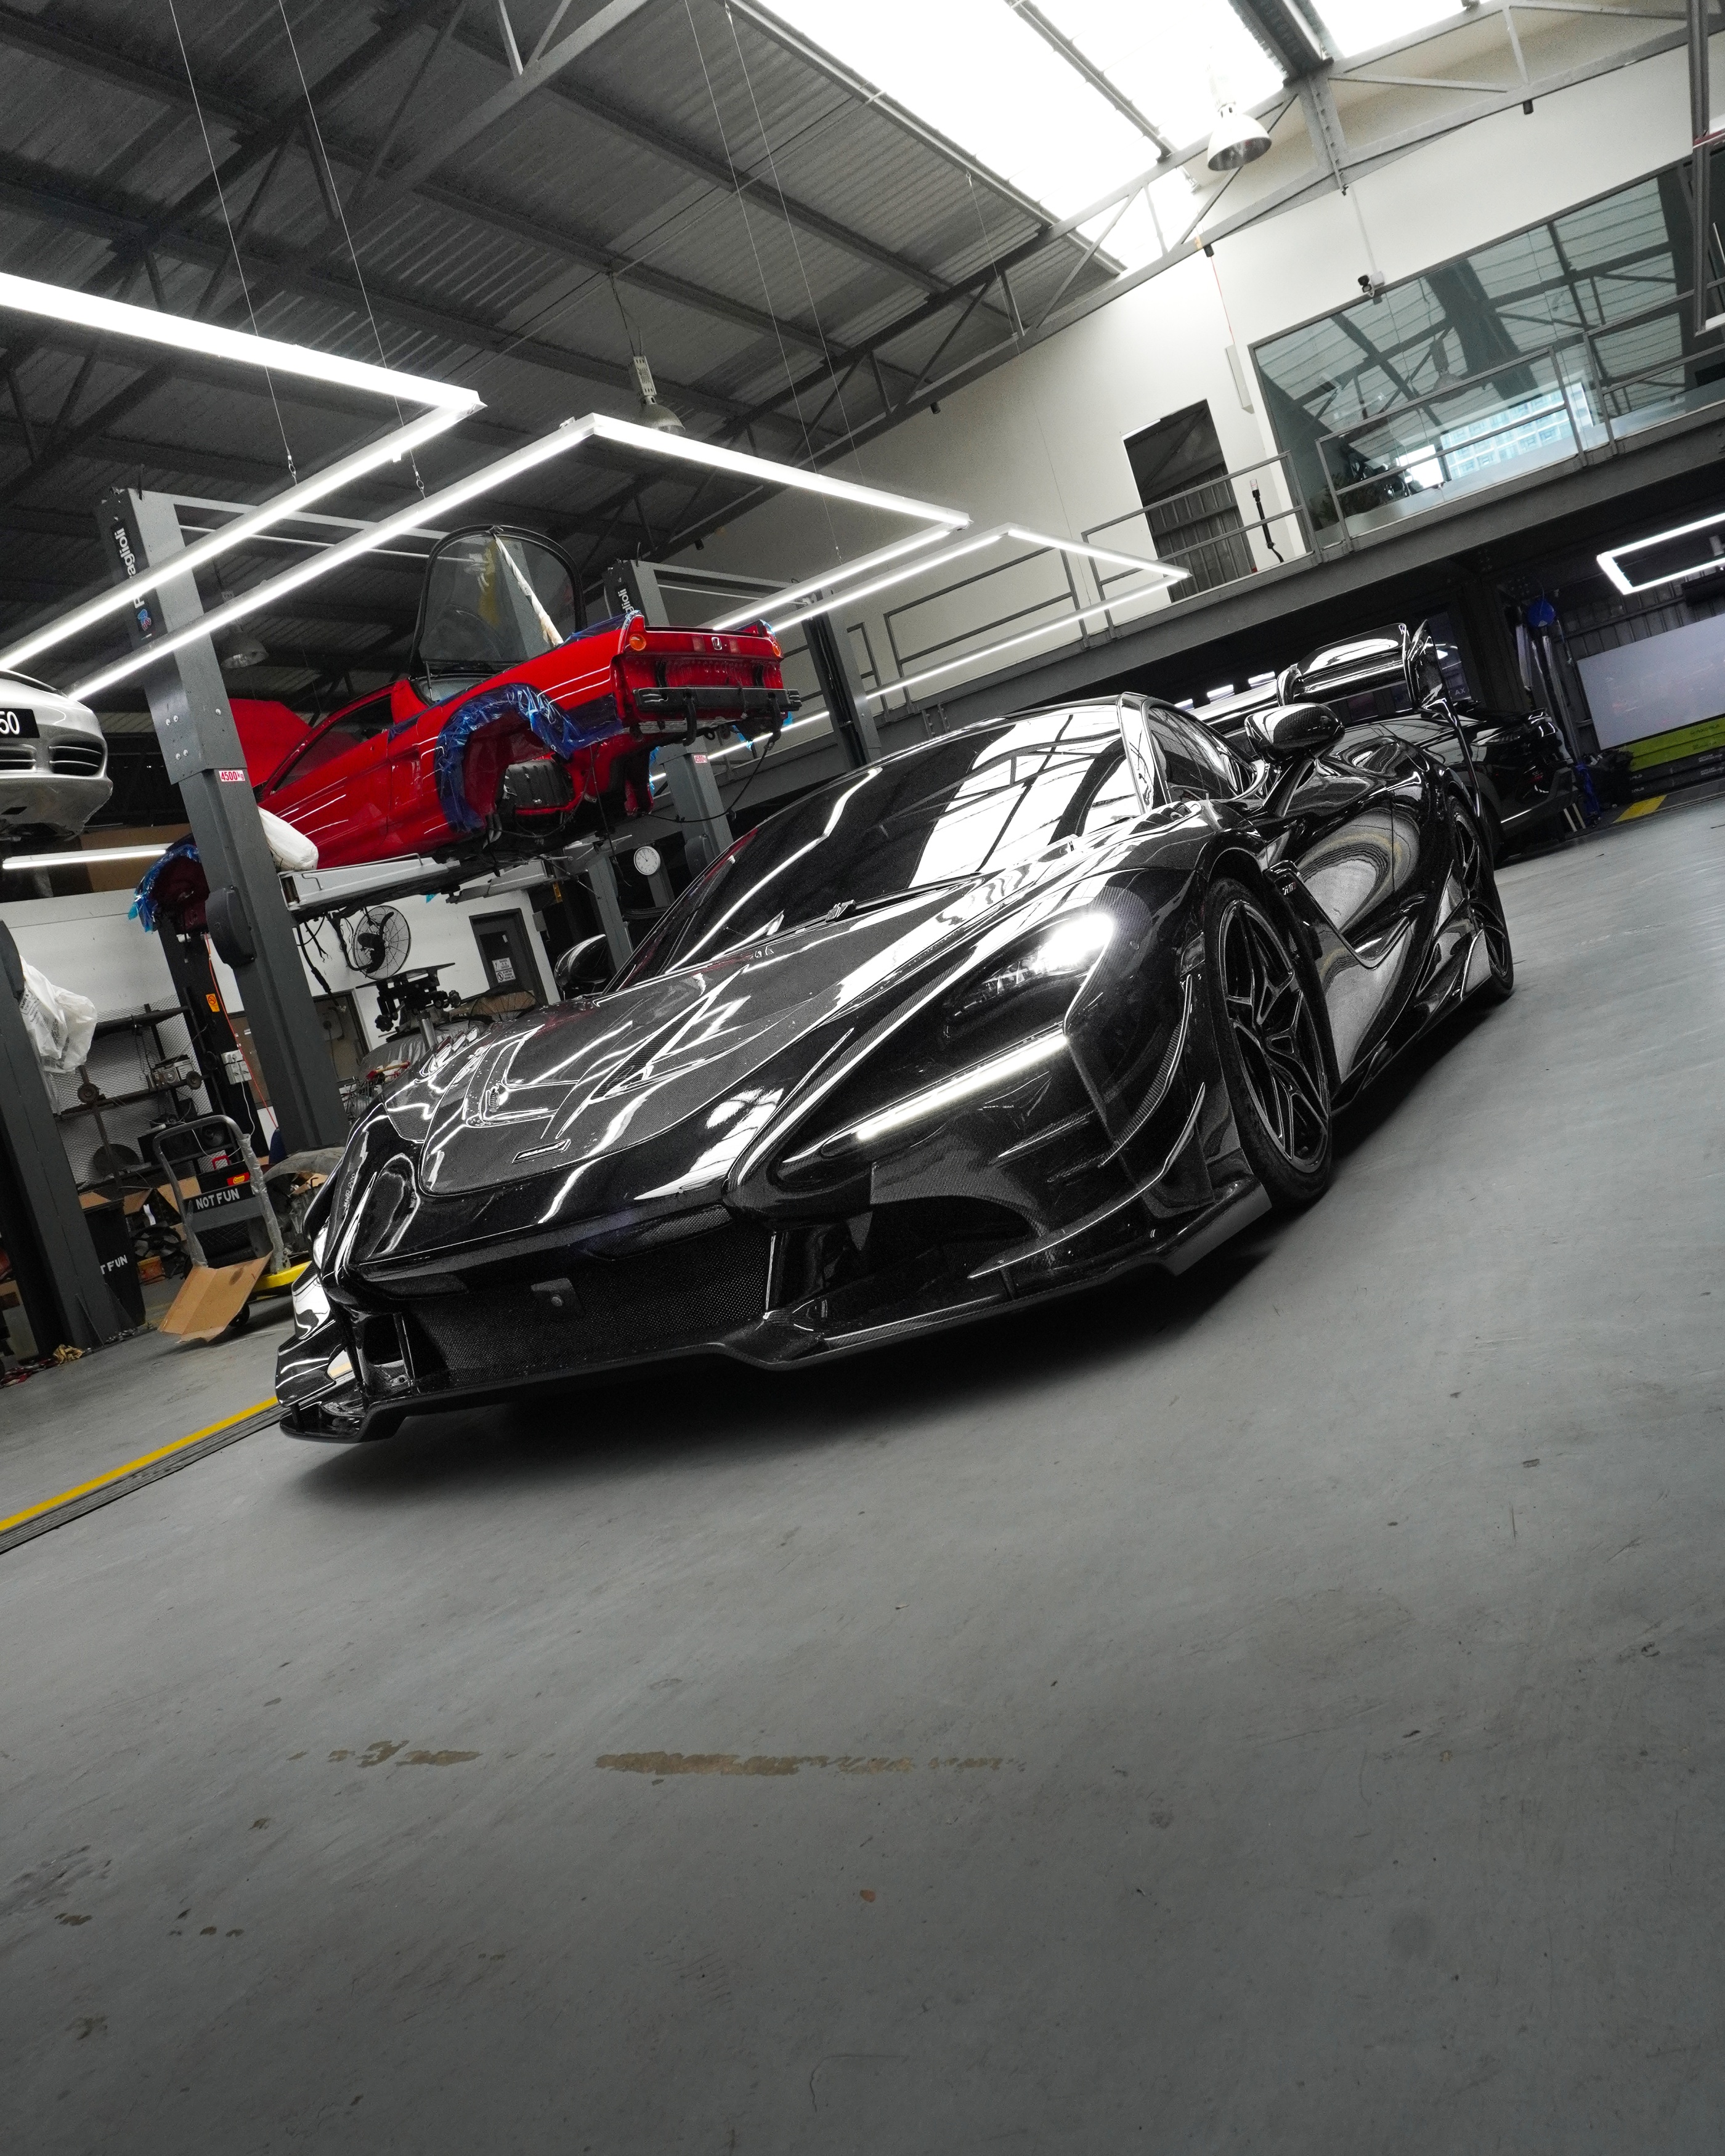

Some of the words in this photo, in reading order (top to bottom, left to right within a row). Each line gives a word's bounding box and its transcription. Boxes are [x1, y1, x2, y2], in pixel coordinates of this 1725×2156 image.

[195, 1194, 214, 1210] NOT
[216, 1188, 240, 1205] FUN
[107, 1254, 128, 1272] FUN
